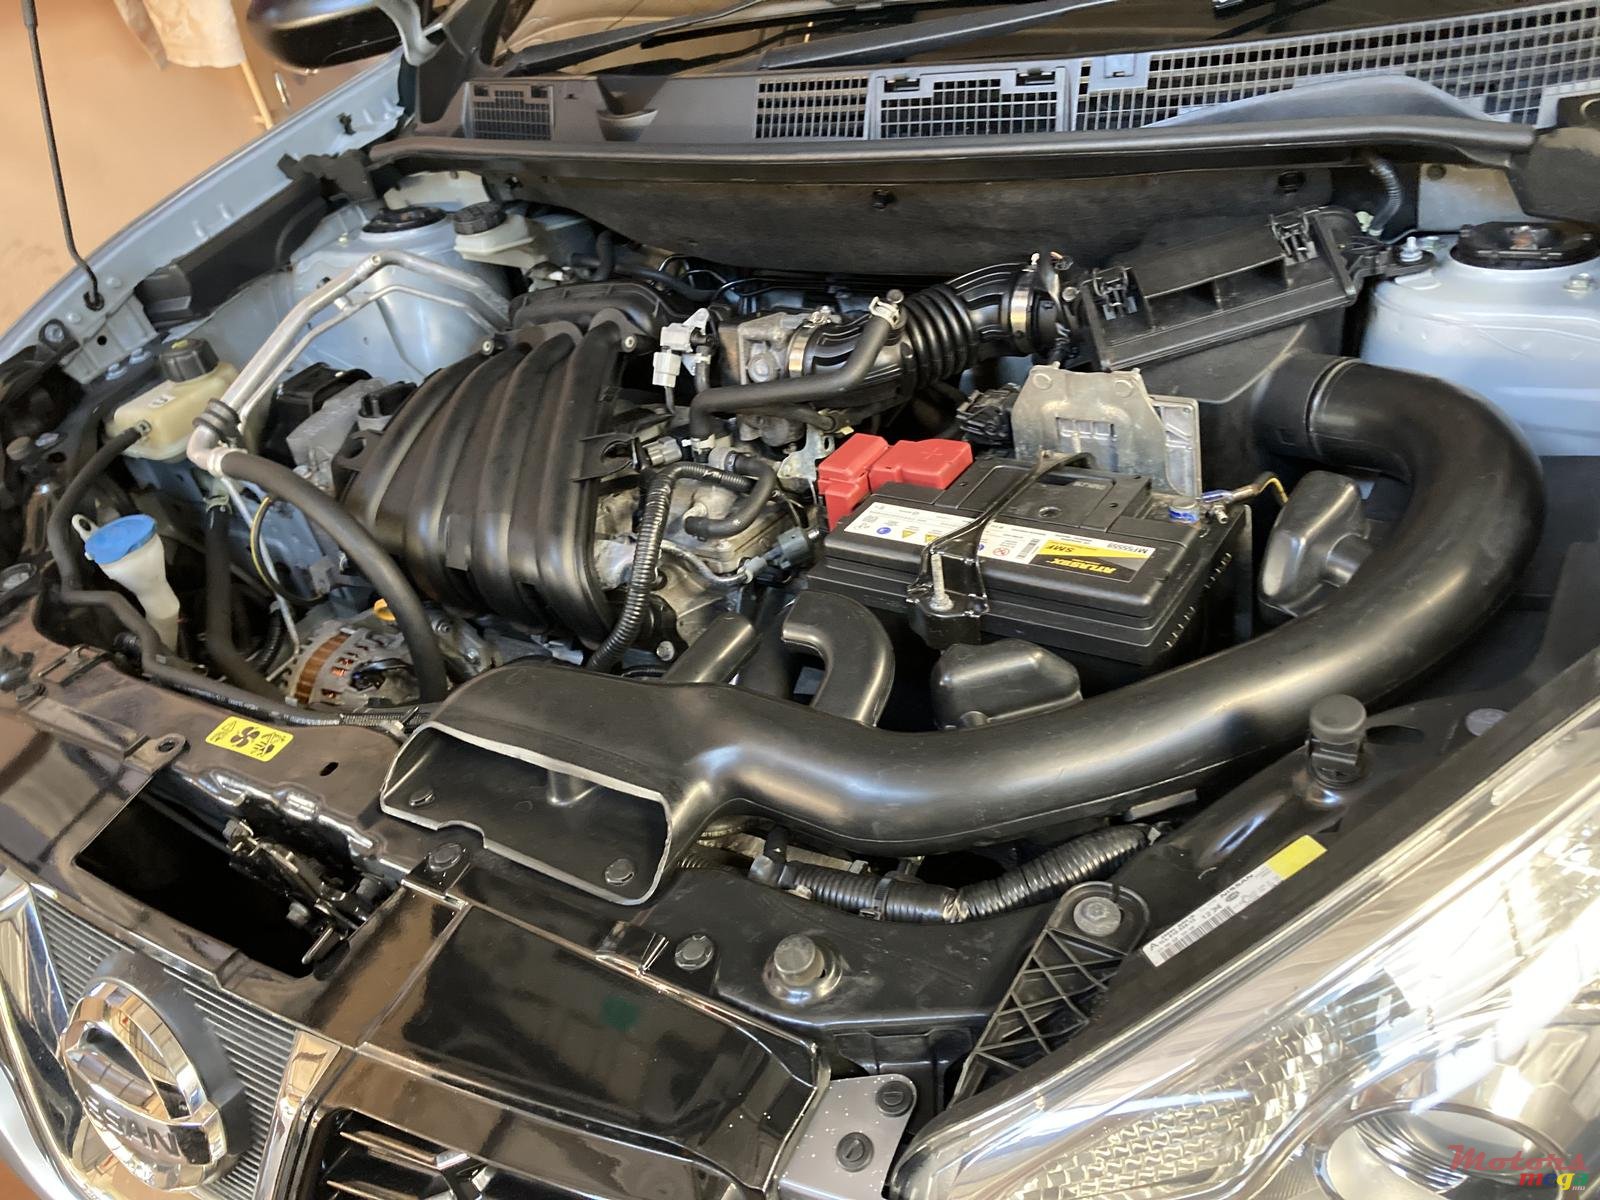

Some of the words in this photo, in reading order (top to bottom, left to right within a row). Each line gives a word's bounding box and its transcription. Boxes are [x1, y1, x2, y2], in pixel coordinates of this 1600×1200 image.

[1045, 544, 1073, 553] SMF
[1219, 873, 1254, 898] NISSAN
[84, 1095, 183, 1157] SSAN
